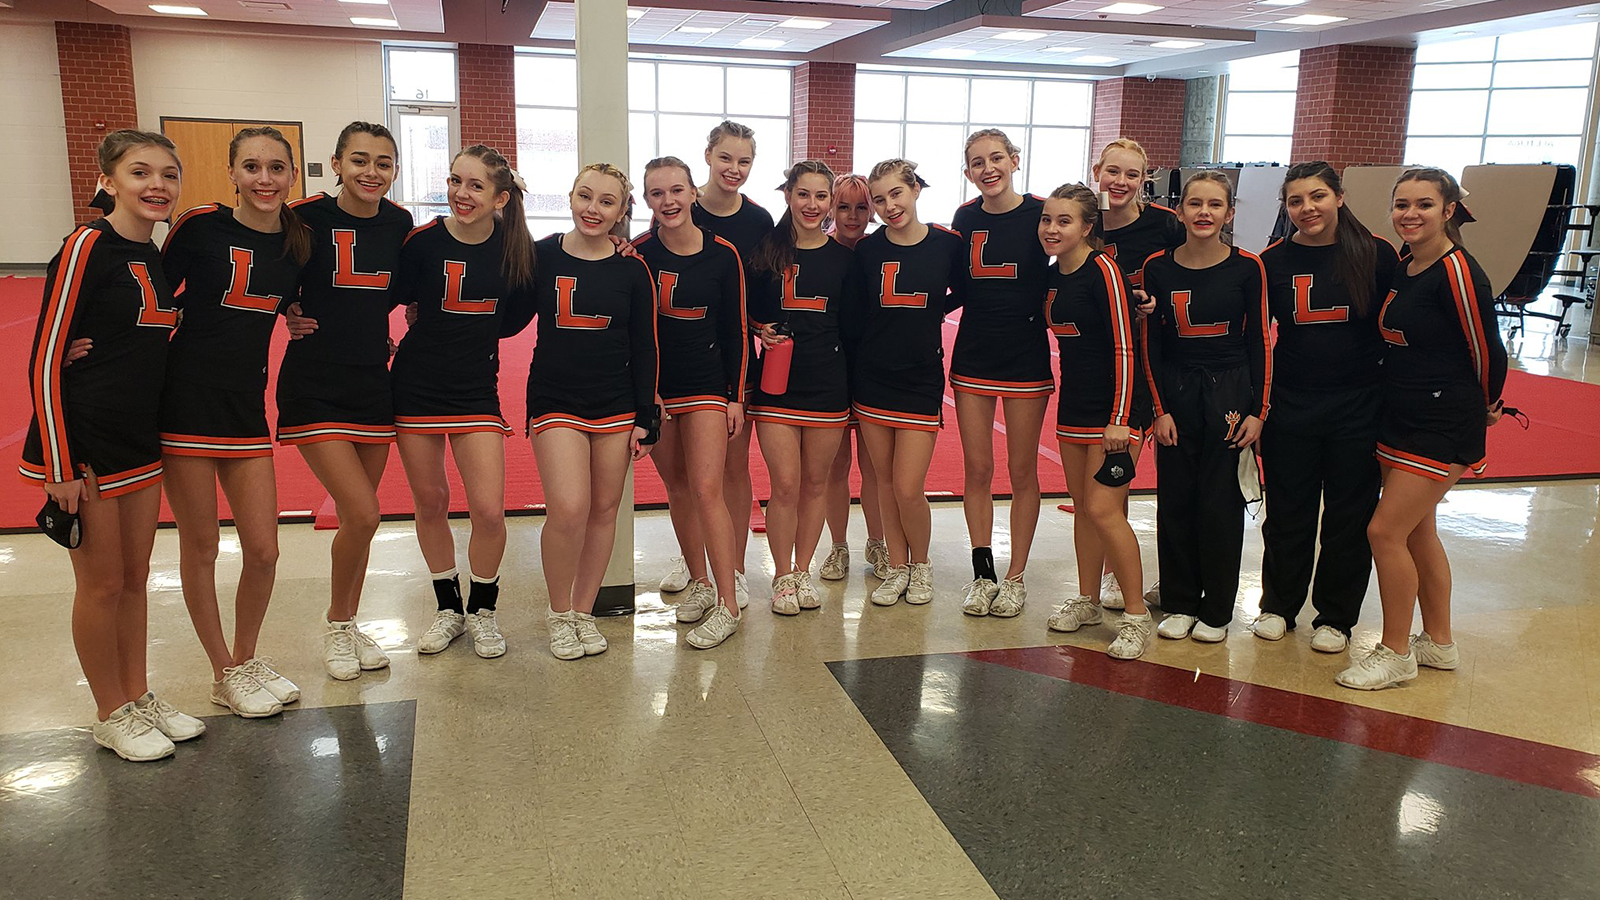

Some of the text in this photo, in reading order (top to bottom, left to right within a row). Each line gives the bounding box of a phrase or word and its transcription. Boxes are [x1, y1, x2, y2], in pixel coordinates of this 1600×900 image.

[222, 246, 282, 313] L
[333, 229, 391, 290] L
[969, 230, 1018, 279] L
[128, 262, 178, 327] L
[441, 260, 498, 314] L
[554, 275, 612, 330] L
[658, 270, 707, 320] L
[781, 264, 828, 312] L
[880, 261, 928, 308] L
[1292, 274, 1349, 324] L
[1044, 288, 1081, 337] L
[1171, 290, 1230, 338] L
[1377, 289, 1409, 347] L
